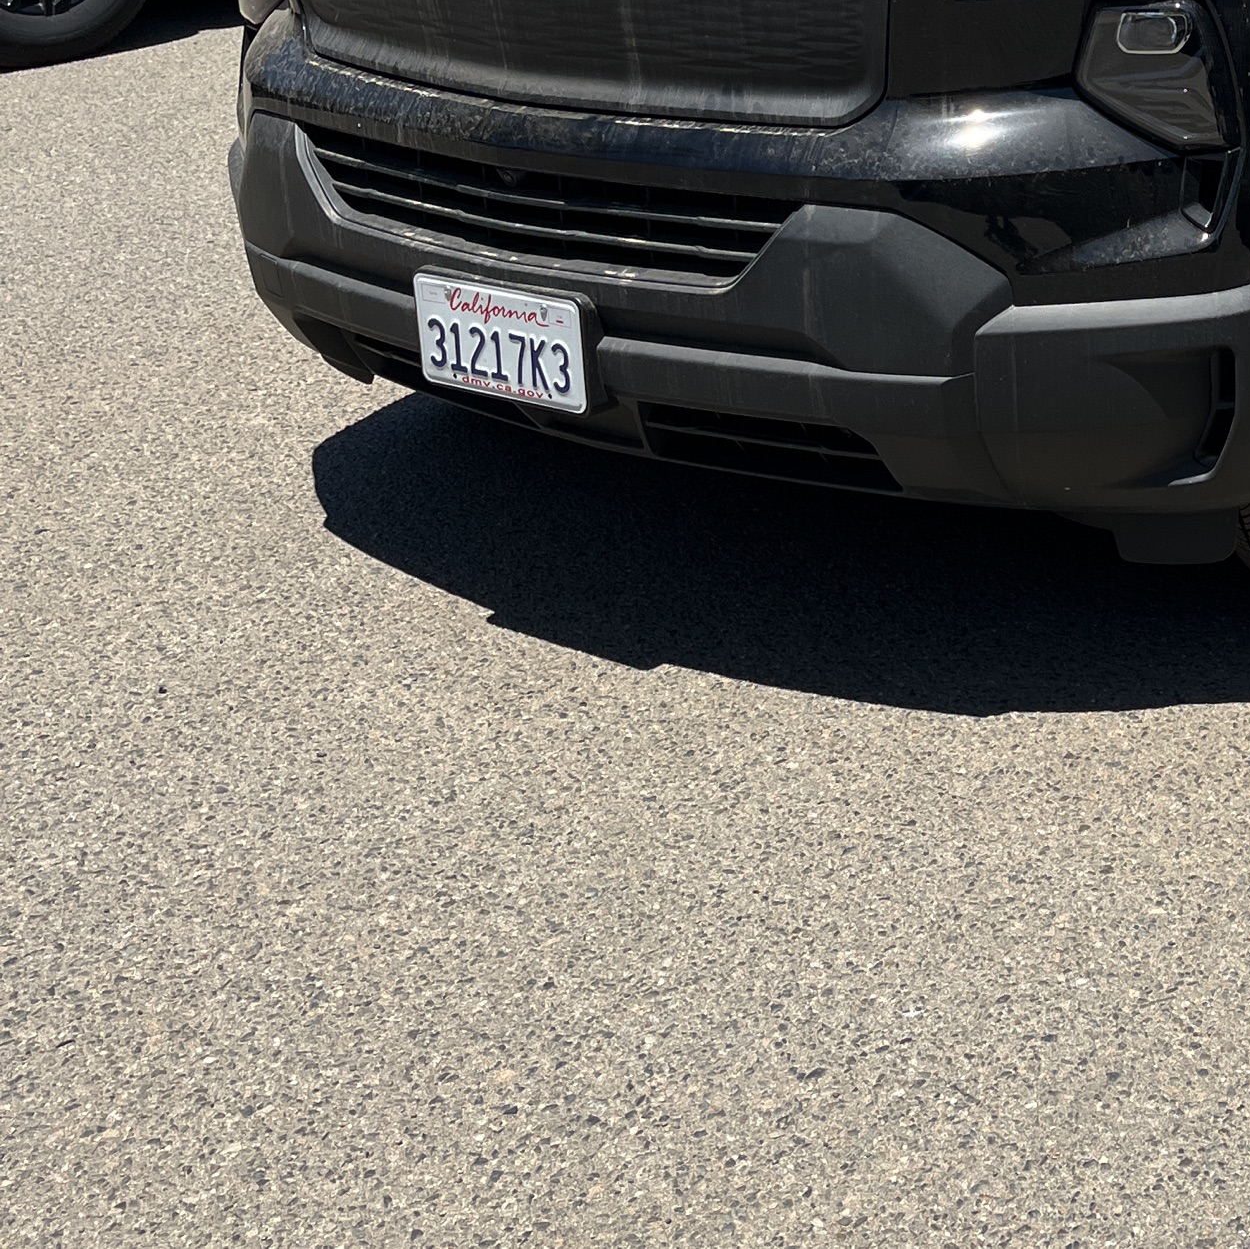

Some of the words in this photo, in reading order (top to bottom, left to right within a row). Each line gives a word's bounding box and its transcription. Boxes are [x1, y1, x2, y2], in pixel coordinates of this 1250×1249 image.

[450, 287, 550, 328] California
[427, 317, 571, 394] 31217K3
[461, 375, 544, 399] dmv.ca.gov
